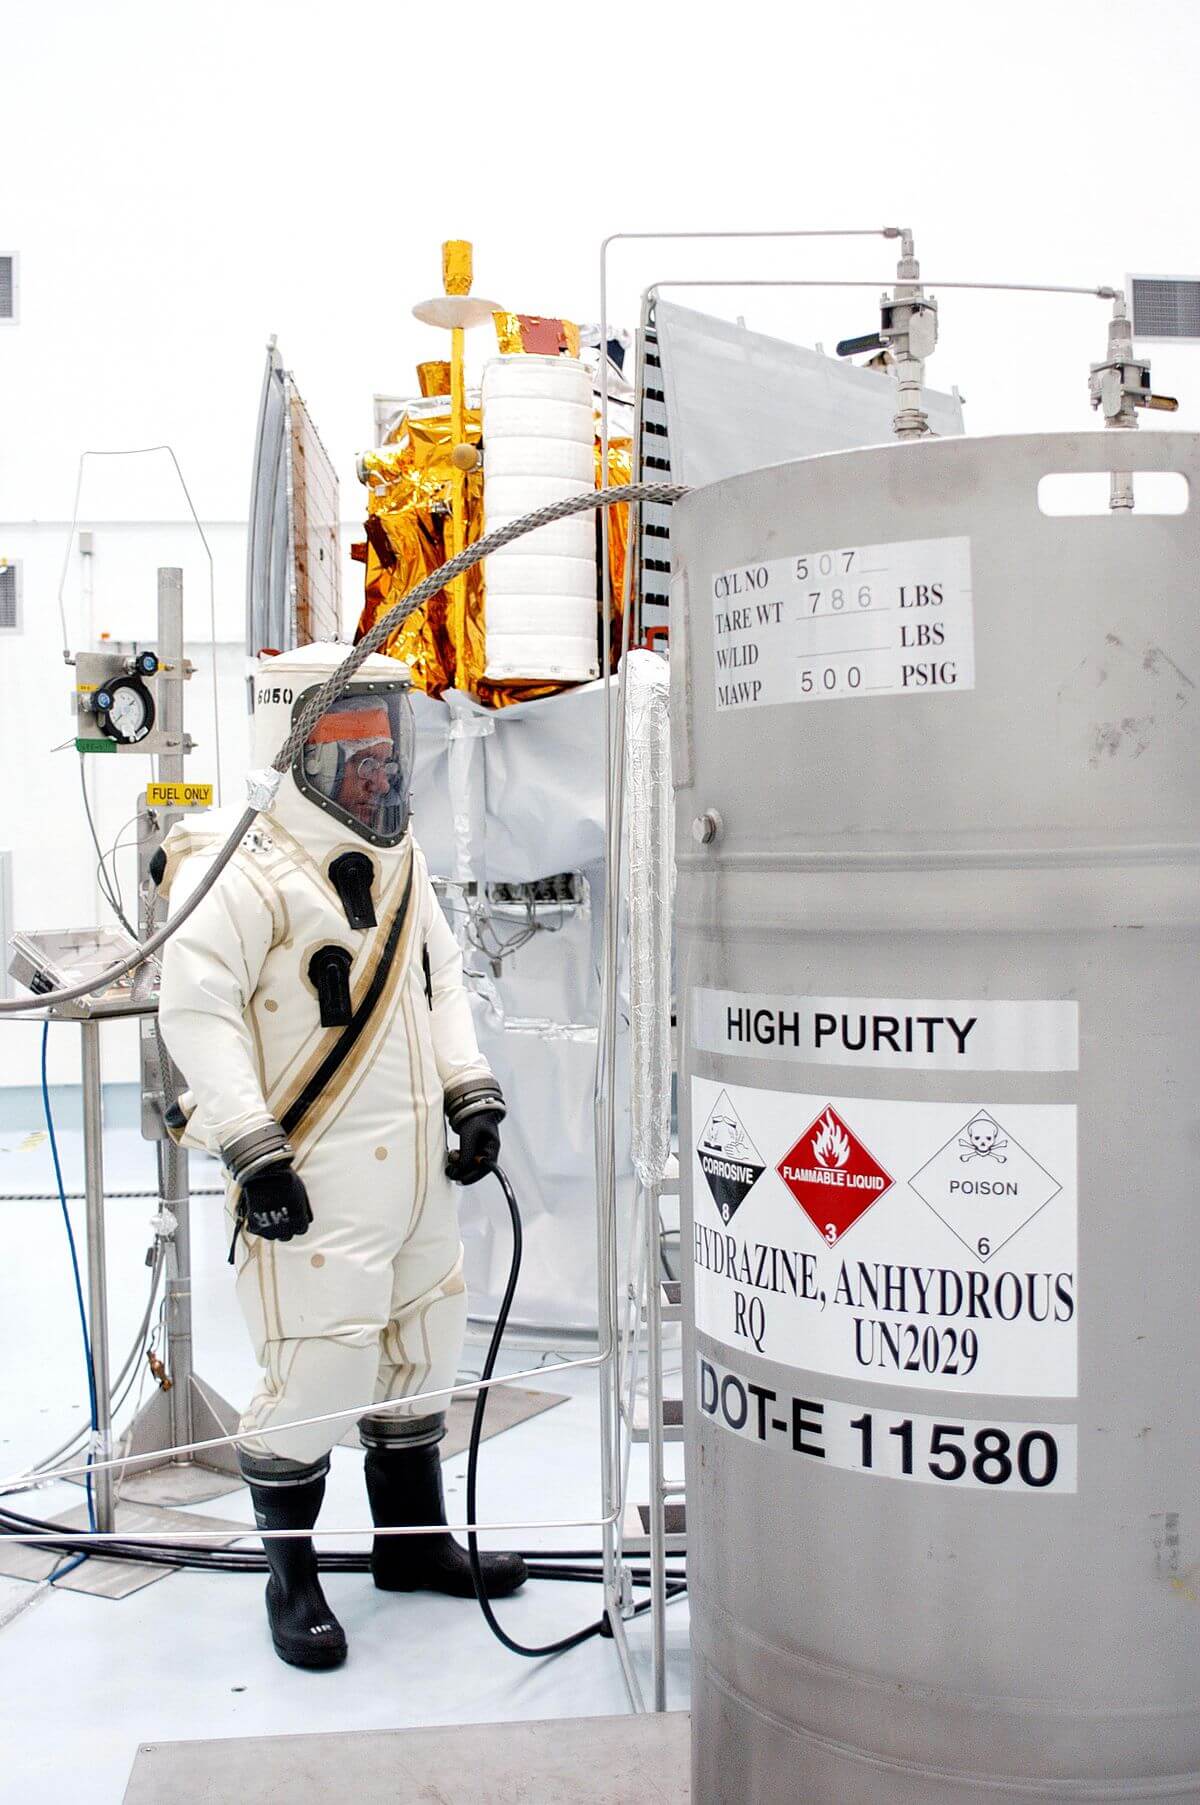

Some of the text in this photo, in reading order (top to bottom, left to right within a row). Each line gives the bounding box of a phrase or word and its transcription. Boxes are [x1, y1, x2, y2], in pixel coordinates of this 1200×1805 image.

[714, 572, 742, 599] CYL
[746, 566, 770, 591] NO
[714, 609, 753, 635] TARE
[756, 601, 785, 626] WT
[899, 583, 945, 609] LBS
[900, 622, 946, 648] LBS
[717, 679, 763, 707] MAWP
[901, 660, 958, 688] PSIG
[151, 786, 210, 801] FUEL ONLY
[726, 1006, 978, 1055] HIGH PURITY
[701, 1155, 754, 1186] CORROSIVE
[783, 1166, 885, 1191] FLAMMABLE LIQUID
[949, 1179, 1019, 1197] POISON
[721, 1202, 731, 1221] 8
[823, 1222, 838, 1243] 3
[976, 1236, 991, 1256] 6
[694, 1221, 1075, 1323] HYDRAZINE, ANHYDROUS
[733, 1290, 980, 1377] RQ UN2029
[700, 1358, 1059, 1488] DOT-E 11580
